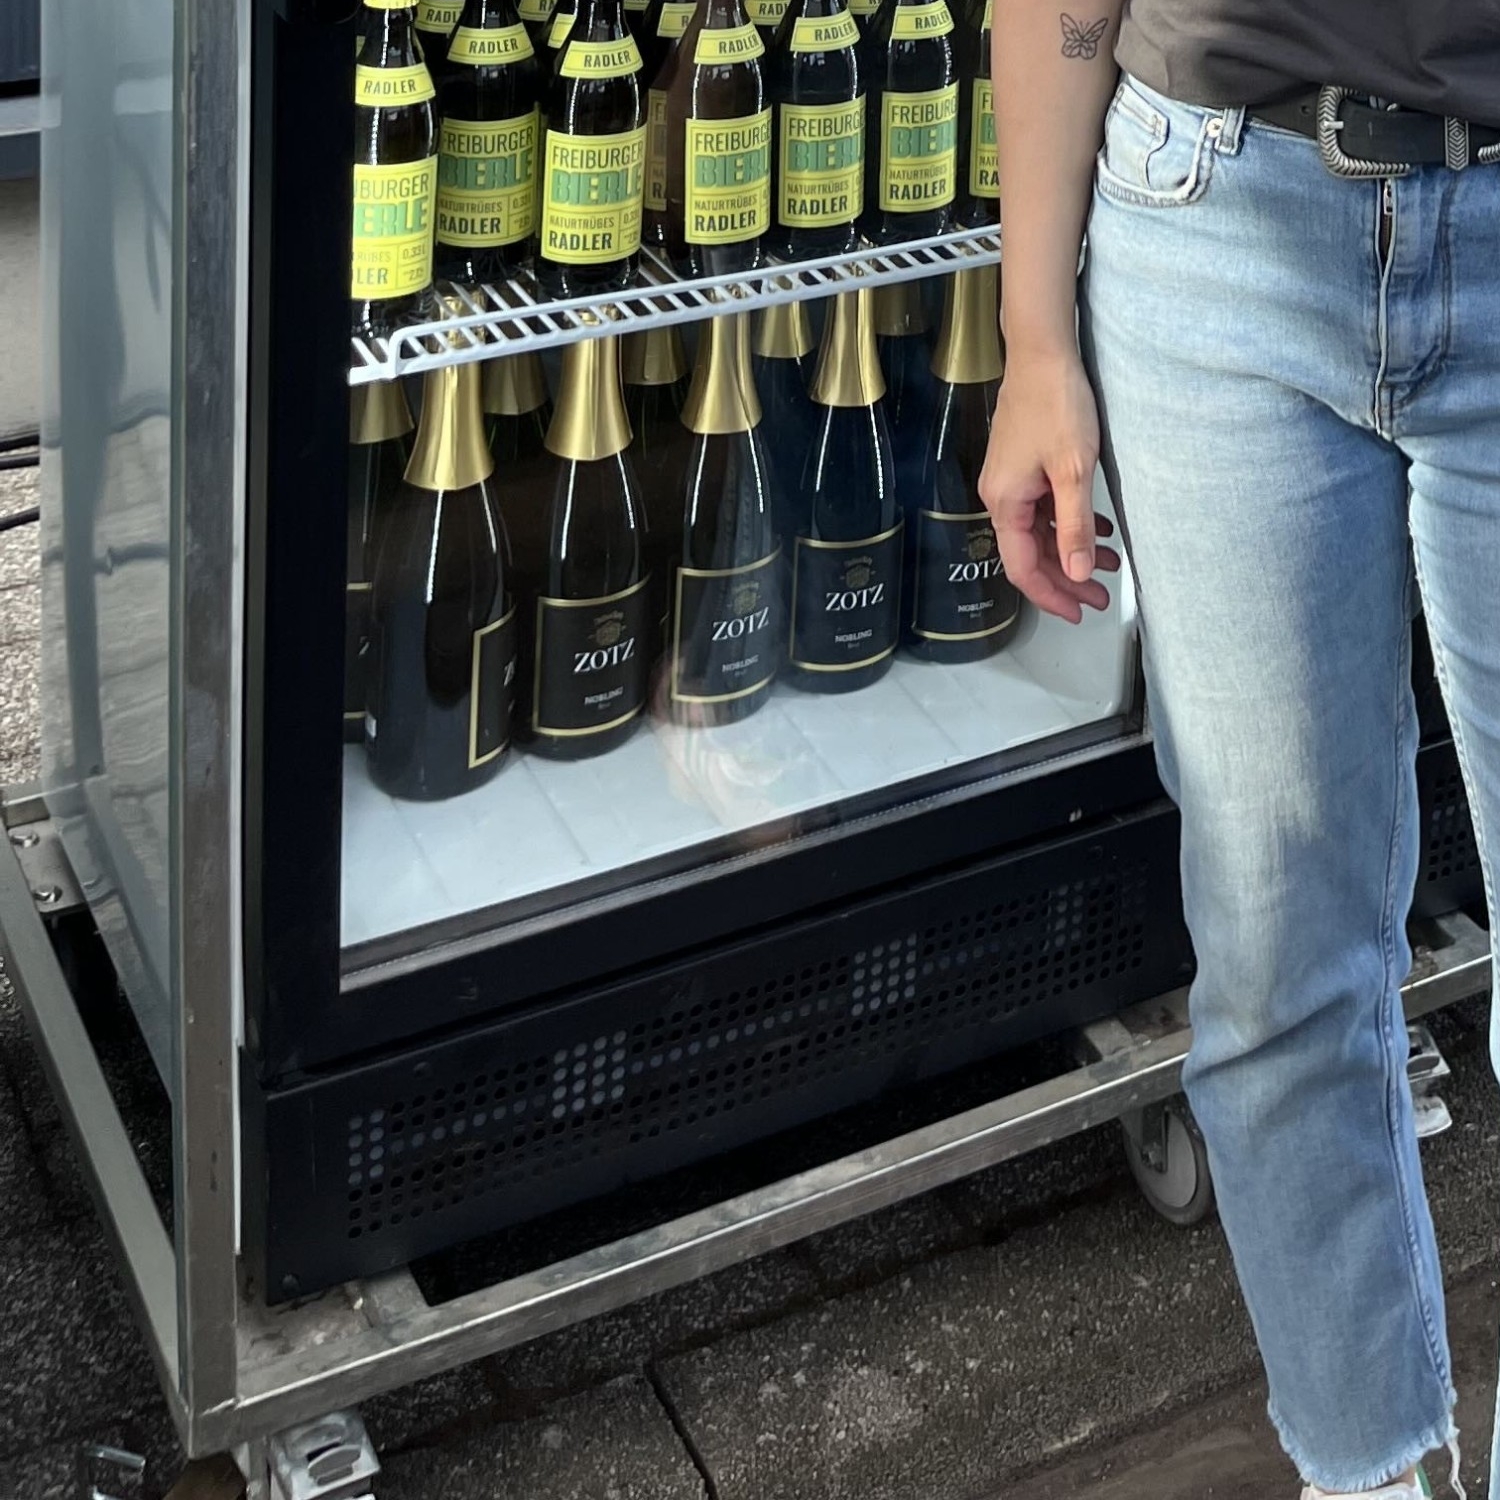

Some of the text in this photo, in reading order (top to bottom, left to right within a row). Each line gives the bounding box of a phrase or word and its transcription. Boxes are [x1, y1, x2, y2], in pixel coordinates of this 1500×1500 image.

[469, 38, 519, 55] RADLER
[584, 50, 631, 67] RADLER
[364, 79, 417, 95] RADLER
[695, 124, 770, 152] FREIBURGE
[552, 140, 643, 170] FREIBURGER
[695, 145, 770, 188] BIERL
[552, 162, 642, 204] BIERLE
[787, 180, 849, 195] NATURTRÜBES
[889, 179, 946, 200] RADLER
[694, 194, 757, 210] NATURTRÜBES
[787, 196, 847, 215] RADLER
[355, 196, 428, 237] ERLE
[439, 216, 501, 235] RADLER
[550, 215, 615, 229] NATURTRÜBES
[694, 210, 757, 232] RADLER
[550, 232, 612, 251] RADLER
[356, 266, 388, 284] LER
[948, 557, 1004, 582] ZOTZ
[825, 583, 884, 611] ZOTZ
[712, 606, 770, 642] ZOTZ
[835, 628, 873, 643] NOBLING
[573, 637, 635, 673] ZOTZ
[584, 686, 624, 706] NOBLING
